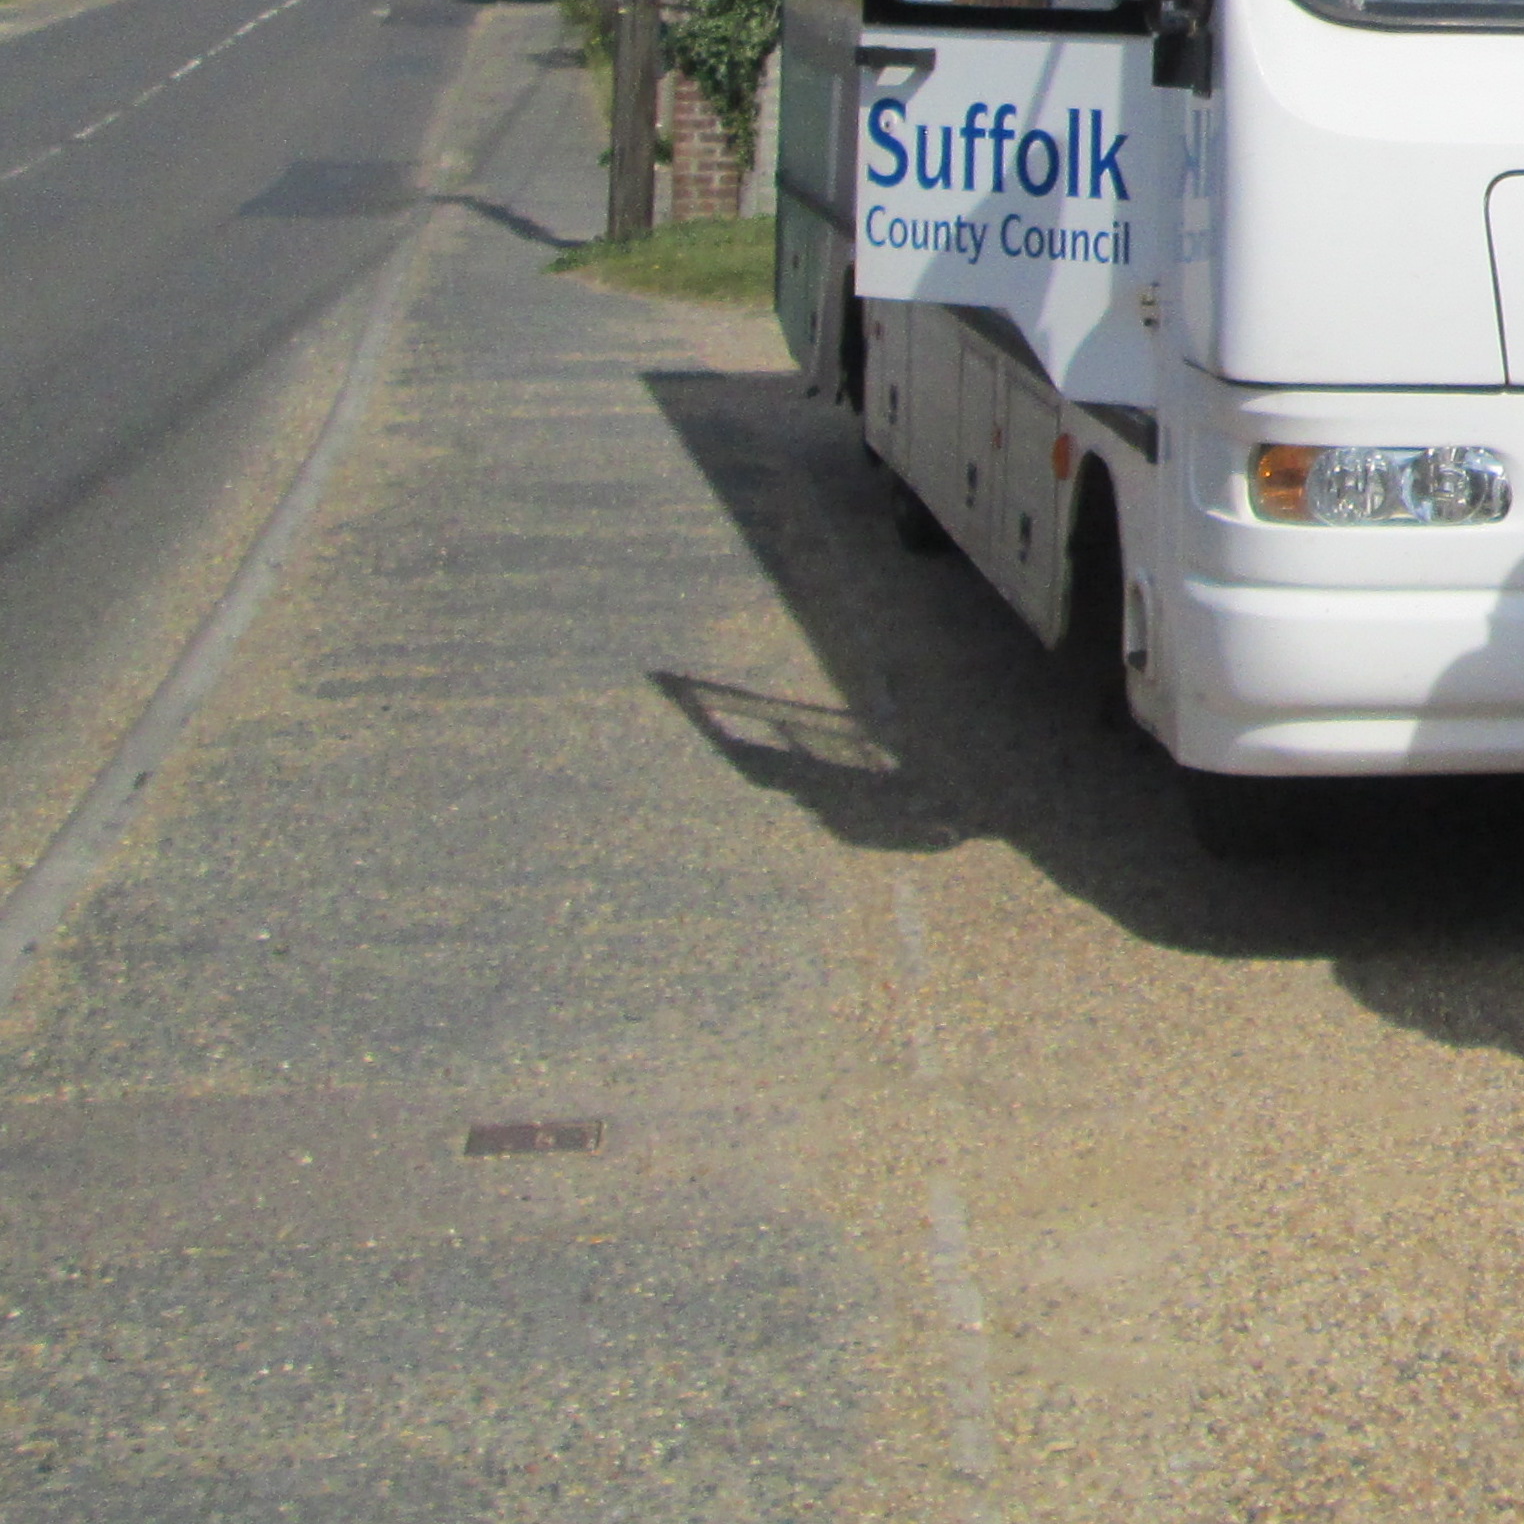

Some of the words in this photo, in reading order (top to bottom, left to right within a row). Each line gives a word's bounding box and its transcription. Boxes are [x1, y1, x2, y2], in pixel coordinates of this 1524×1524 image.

[866, 97, 1131, 201] Suffolk
[866, 204, 987, 264] County
[1000, 213, 1130, 265] Council
